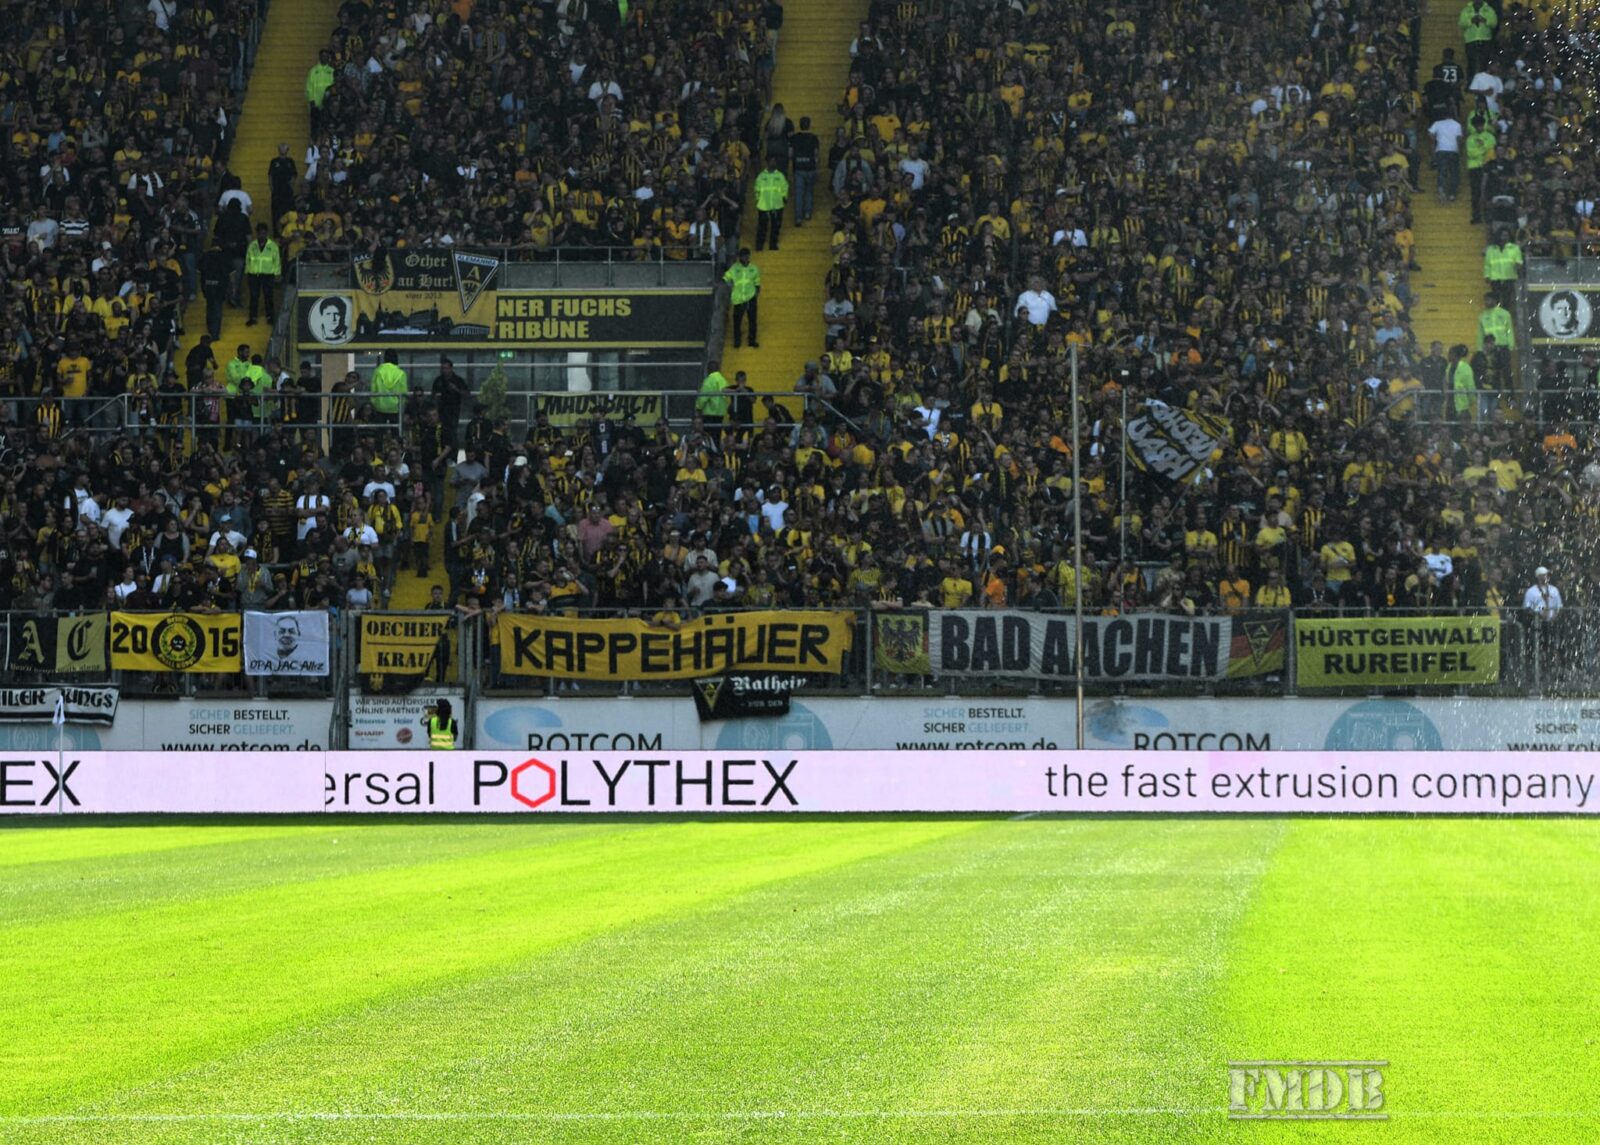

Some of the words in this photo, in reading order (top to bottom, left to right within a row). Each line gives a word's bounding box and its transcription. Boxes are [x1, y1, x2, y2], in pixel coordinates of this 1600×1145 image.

[1442, 68, 1458, 82] 23
[551, 298, 632, 317] FUCHS
[495, 318, 590, 339] RIBÜNE
[112, 622, 148, 654] 20
[366, 620, 443, 637] OECHER
[1299, 627, 1497, 648] HÜRTGENWALD
[208, 627, 239, 657] 15
[512, 616, 830, 674] KAPPEHÄUER
[941, 614, 1031, 672] BAD
[1040, 617, 1220, 677] AACHEN
[250, 660, 273, 671] OPA
[1324, 652, 1477, 675] RUREIFEL
[189, 709, 231, 721] SICHER
[233, 709, 290, 721] BESTELLT.
[968, 707, 1026, 719] BESTELLT.
[189, 723, 231, 735] SICHER
[233, 724, 296, 735] GELIEFERT.
[923, 722, 966, 733] SICHER
[528, 732, 663, 750] ROTCOM
[1134, 732, 1271, 750] ROTCOM
[0, 760, 81, 806] EX
[473, 758, 800, 809] POLYTHEX
[1045, 764, 1108, 798] the
[1121, 764, 1198, 798] fast
[1211, 765, 1398, 798] extrusion
[1412, 773, 1595, 808] company
